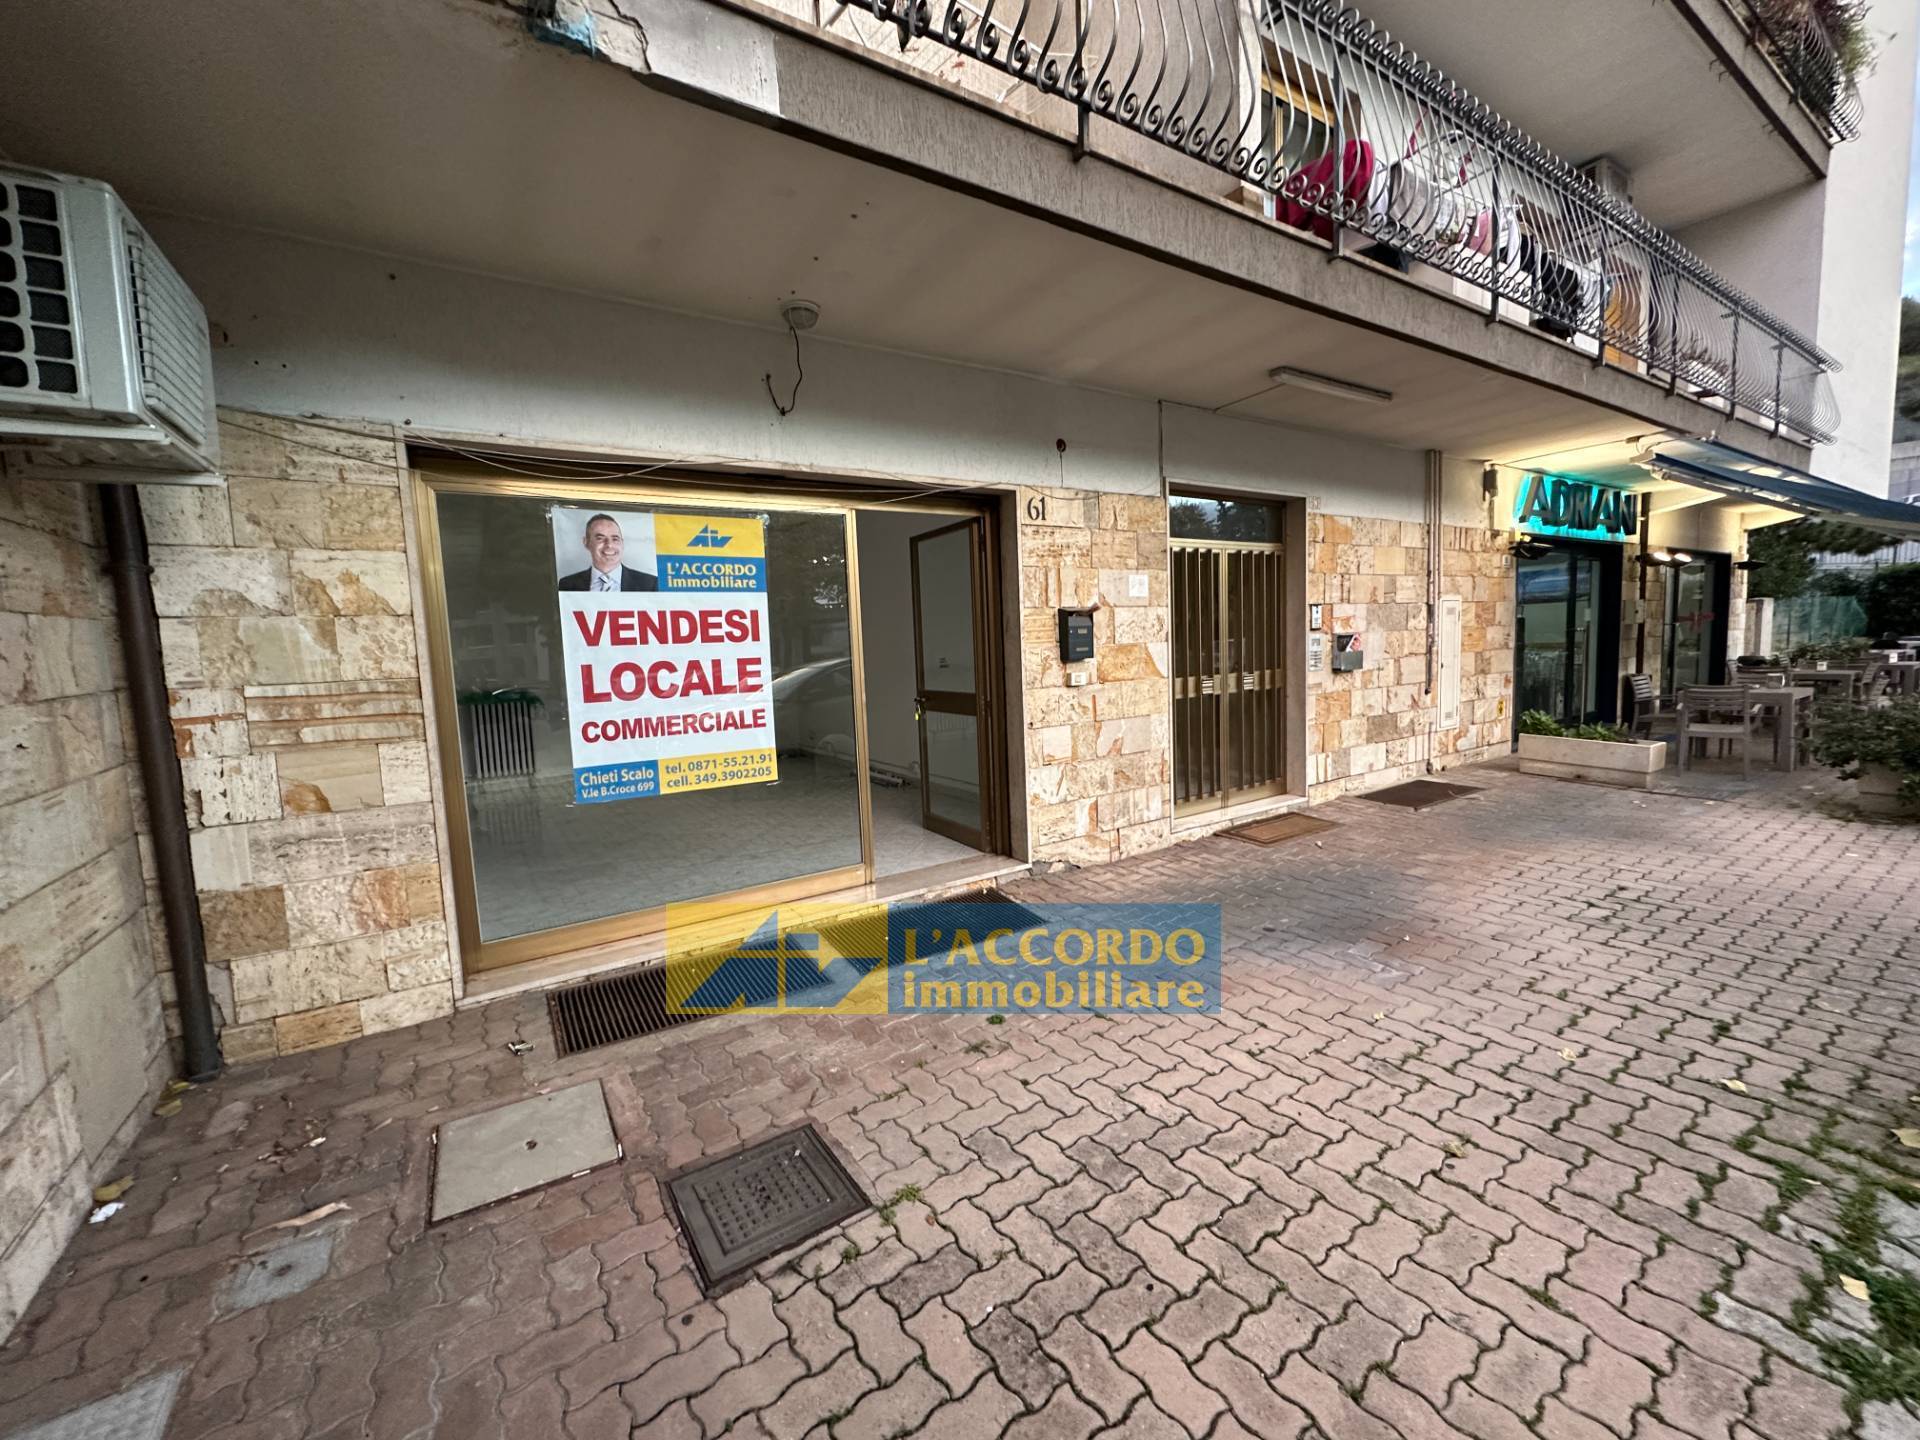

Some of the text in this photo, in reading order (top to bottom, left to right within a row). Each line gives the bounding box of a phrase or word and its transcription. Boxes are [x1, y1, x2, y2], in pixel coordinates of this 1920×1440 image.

[1027, 496, 1047, 521] 61
[1519, 474, 1637, 535] ADRIAN
[667, 562, 756, 576] L'ACCORDO
[668, 576, 757, 588] immobiliare
[573, 609, 760, 646] VENDESI
[580, 657, 764, 704] LOCALE
[581, 708, 767, 744] COMMERCIALE
[665, 754, 773, 775] tel. 0871-55.21.91
[580, 767, 654, 787] Chieti Scalo
[666, 767, 772, 788] cell. 349.3902205
[581, 781, 655, 799] V.le B.Croce 699
